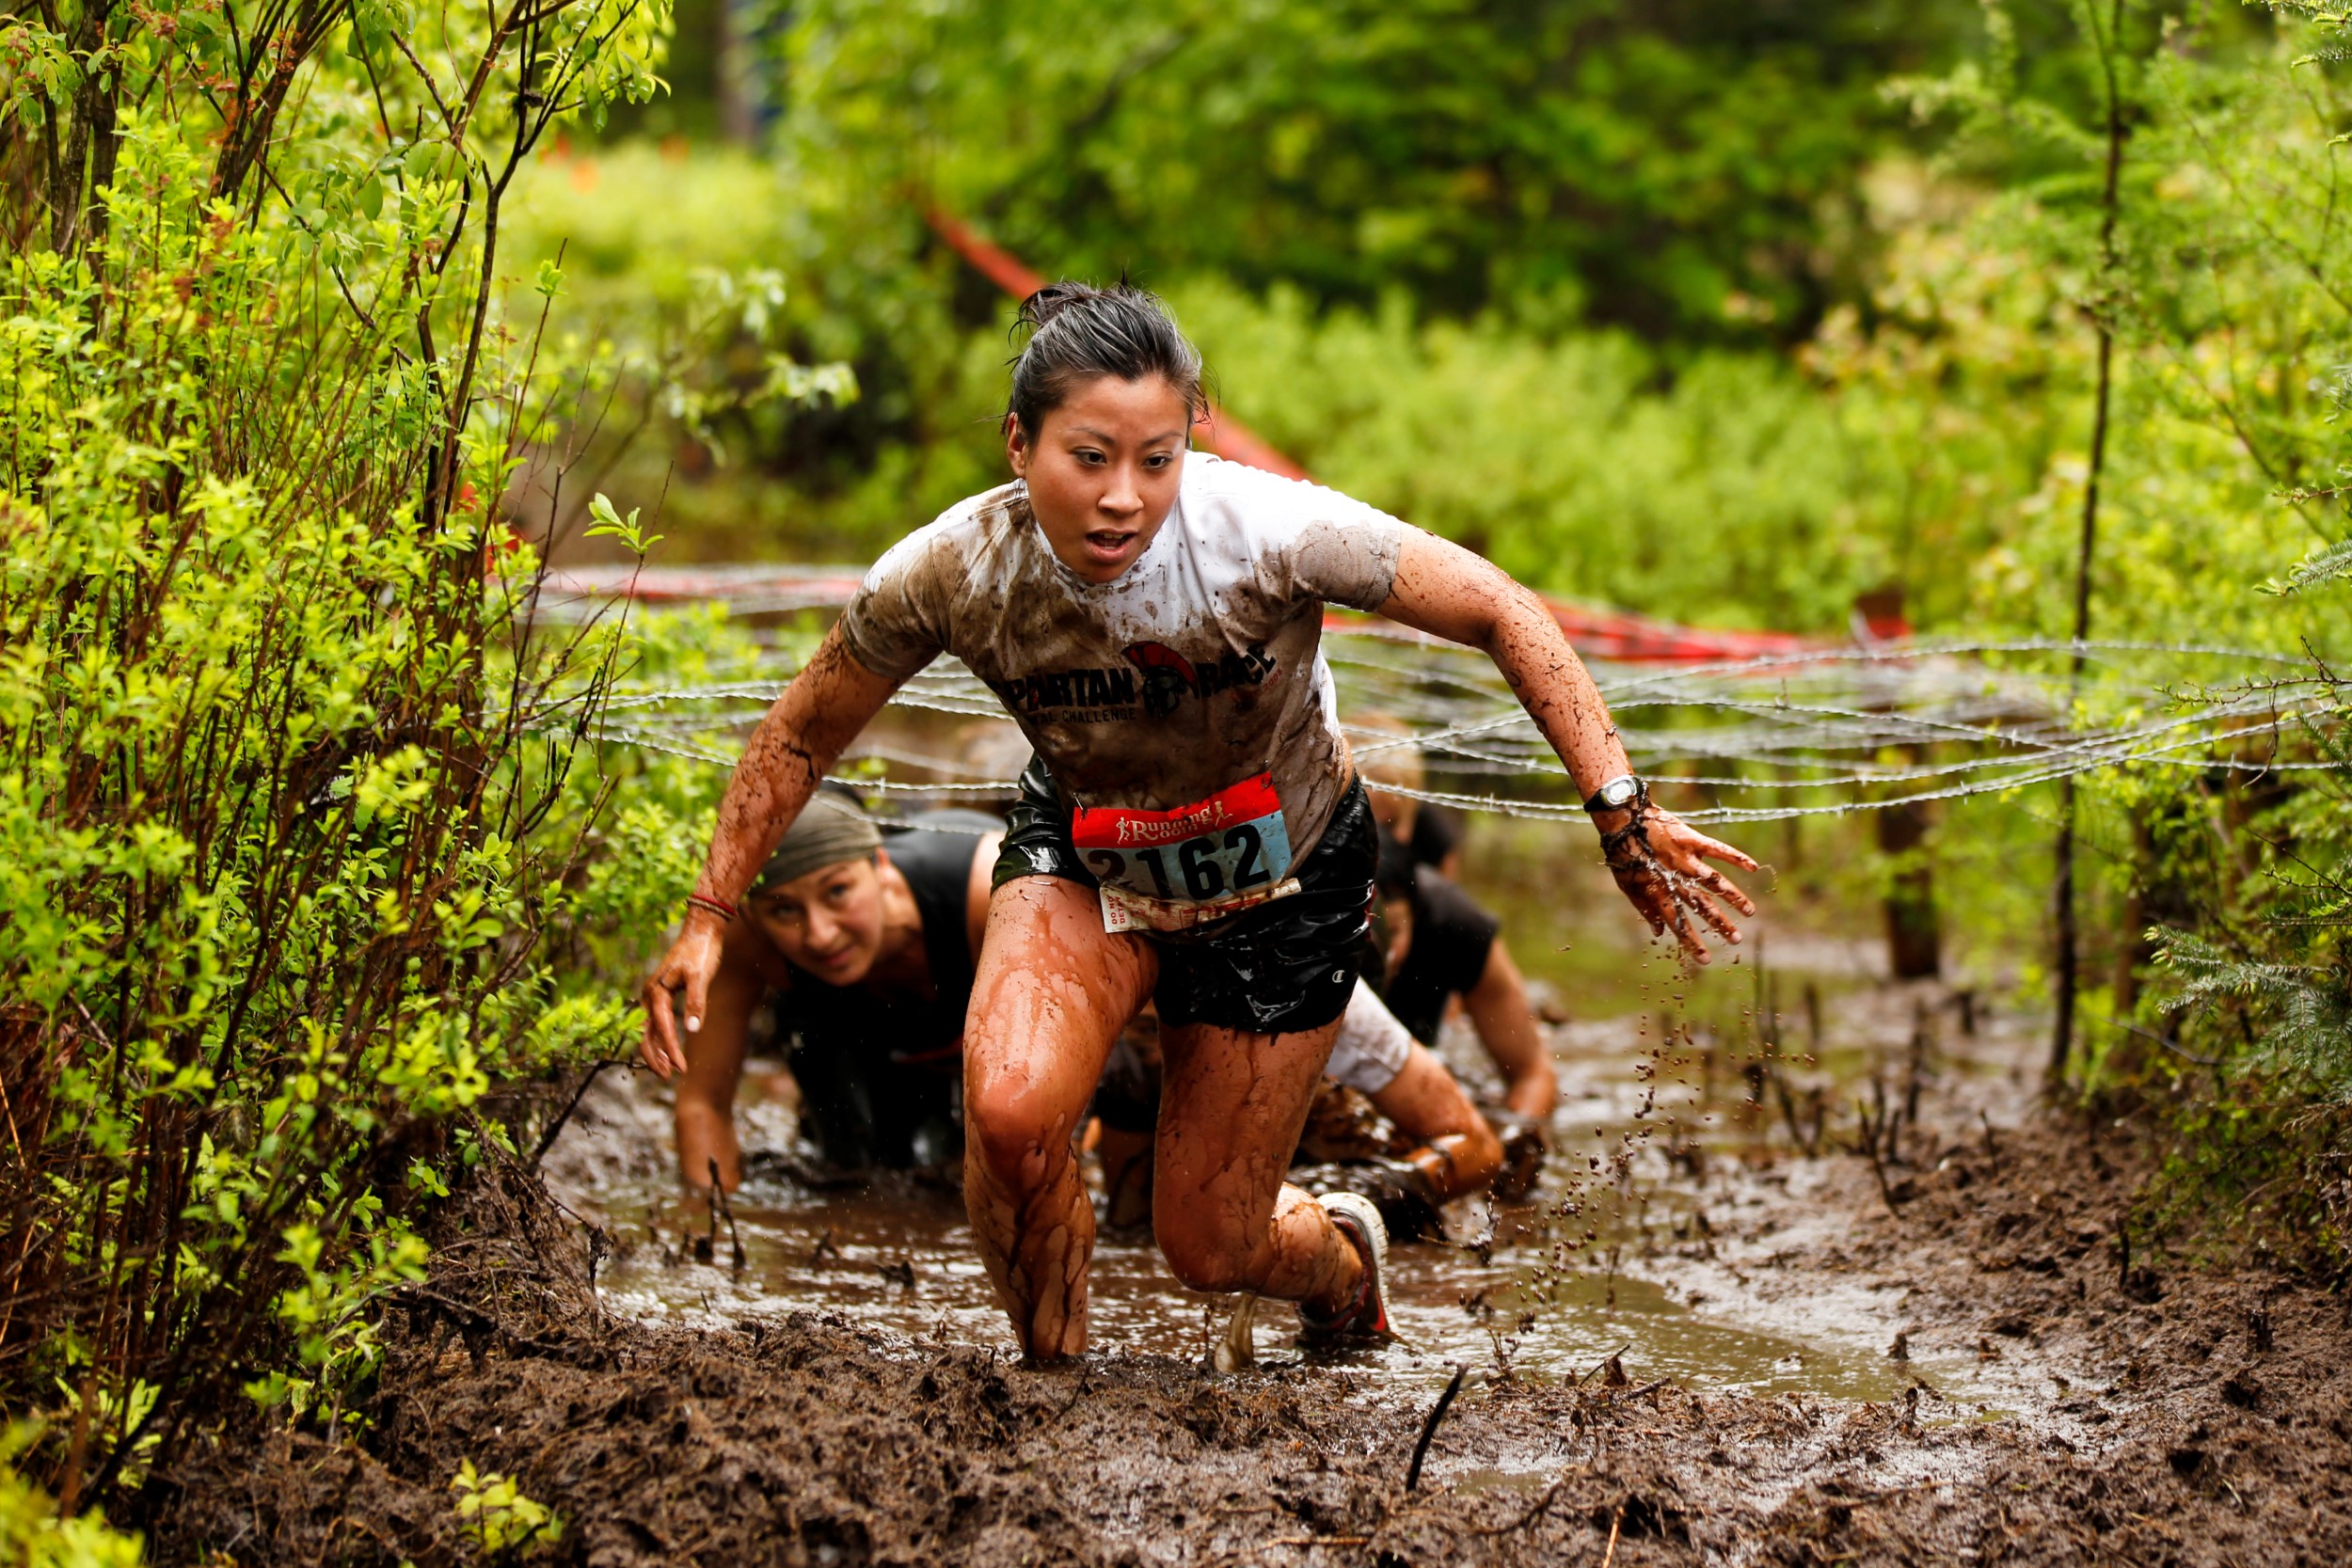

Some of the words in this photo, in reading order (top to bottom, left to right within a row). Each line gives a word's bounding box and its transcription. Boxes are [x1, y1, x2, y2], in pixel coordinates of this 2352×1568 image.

[1061, 707, 1136, 723] CHALLENGE
[1087, 824, 1272, 901] 2162
[1110, 912, 1118, 925] DO
